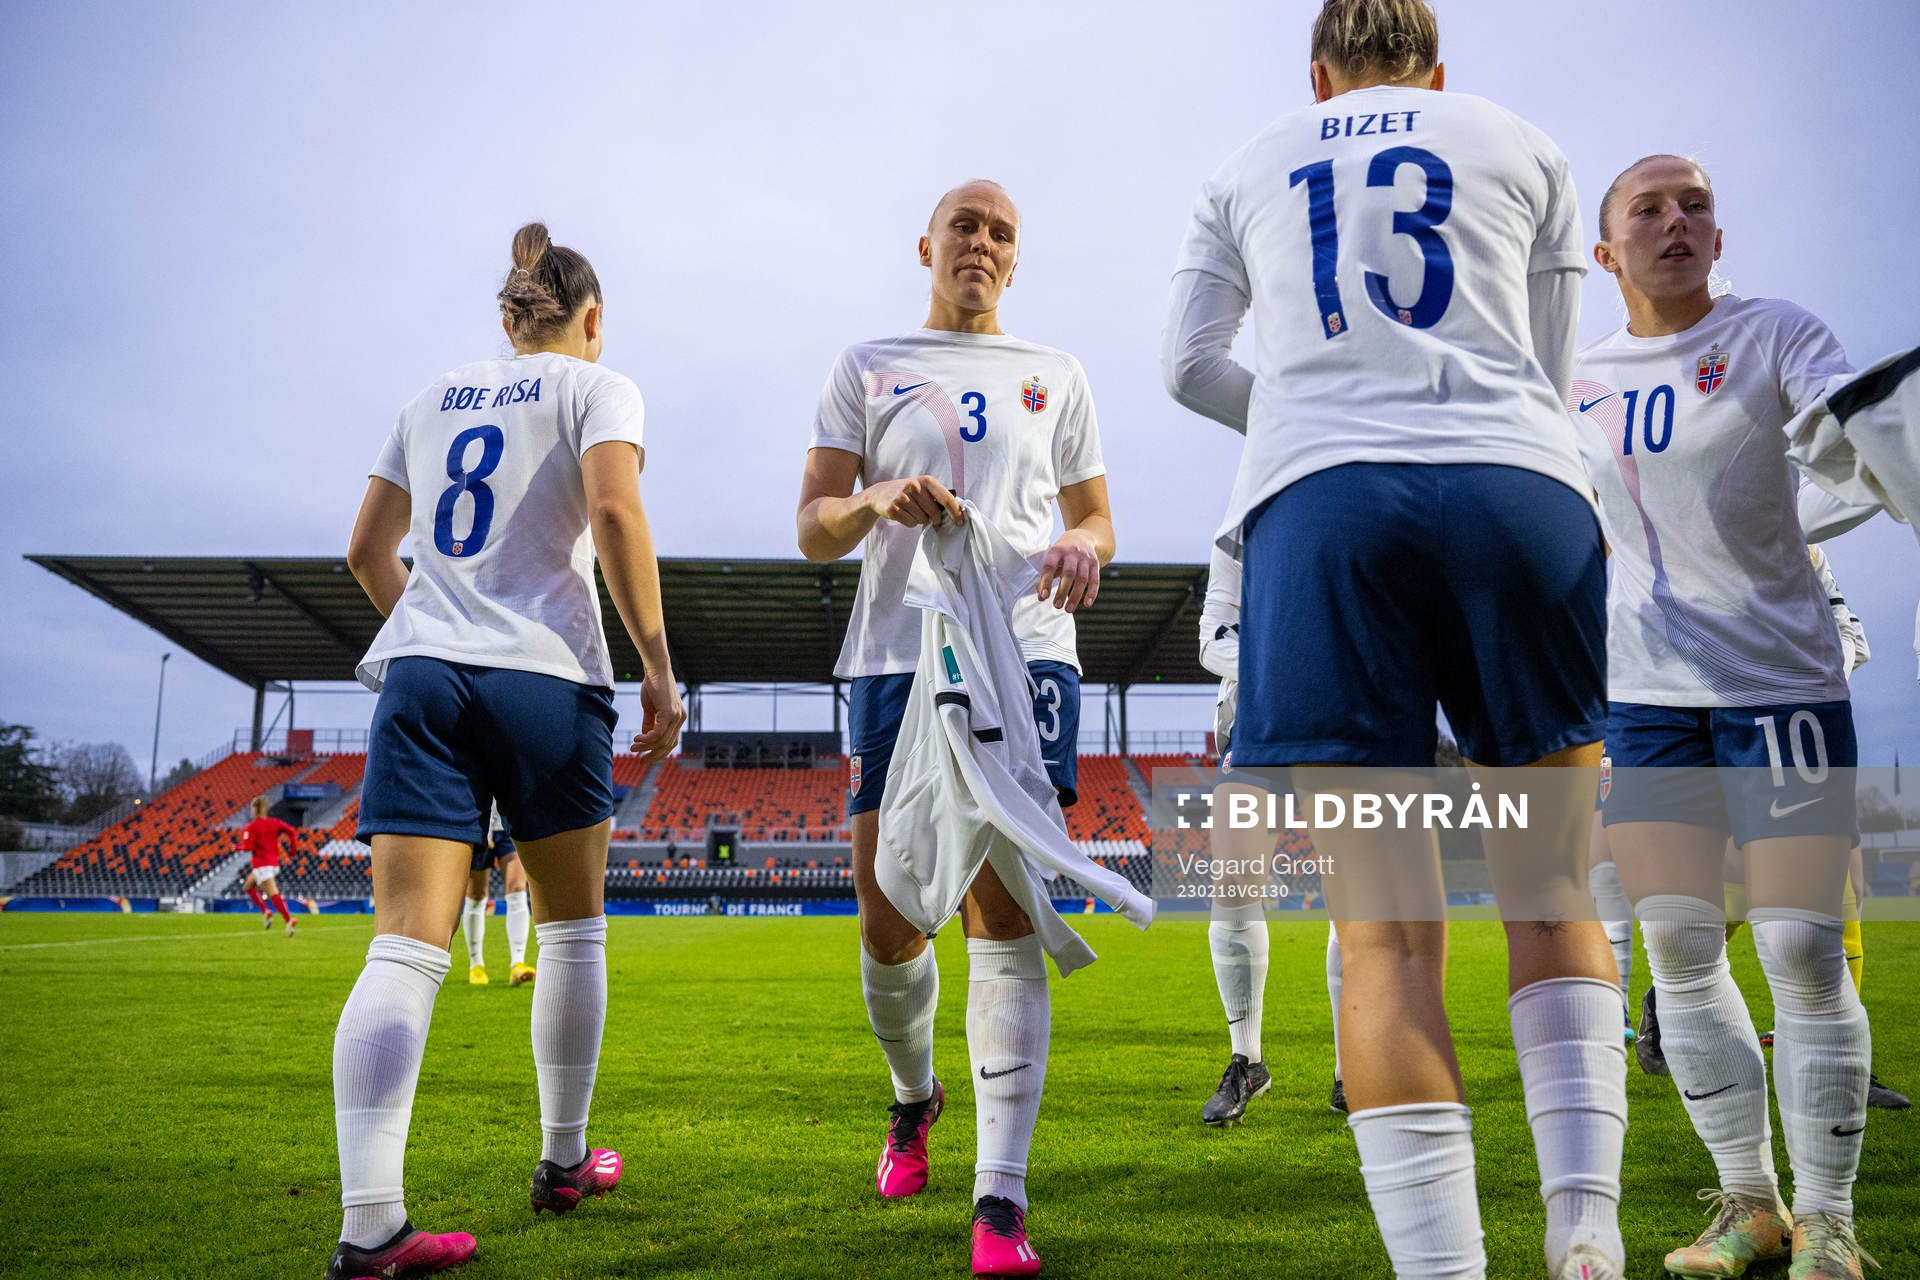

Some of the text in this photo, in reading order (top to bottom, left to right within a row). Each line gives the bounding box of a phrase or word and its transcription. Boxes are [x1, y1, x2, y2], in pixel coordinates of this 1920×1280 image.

[1320, 109, 1421, 141] BIZET
[1289, 145, 1455, 341] 13
[440, 377, 542, 412] BØE RISA
[959, 391, 987, 443] 3
[1622, 384, 1675, 456] 10
[433, 424, 505, 558] 8
[1038, 678, 1061, 742] 3
[1753, 709, 1829, 787] 10
[654, 903, 804, 916] TOURNO DE FRANCE
